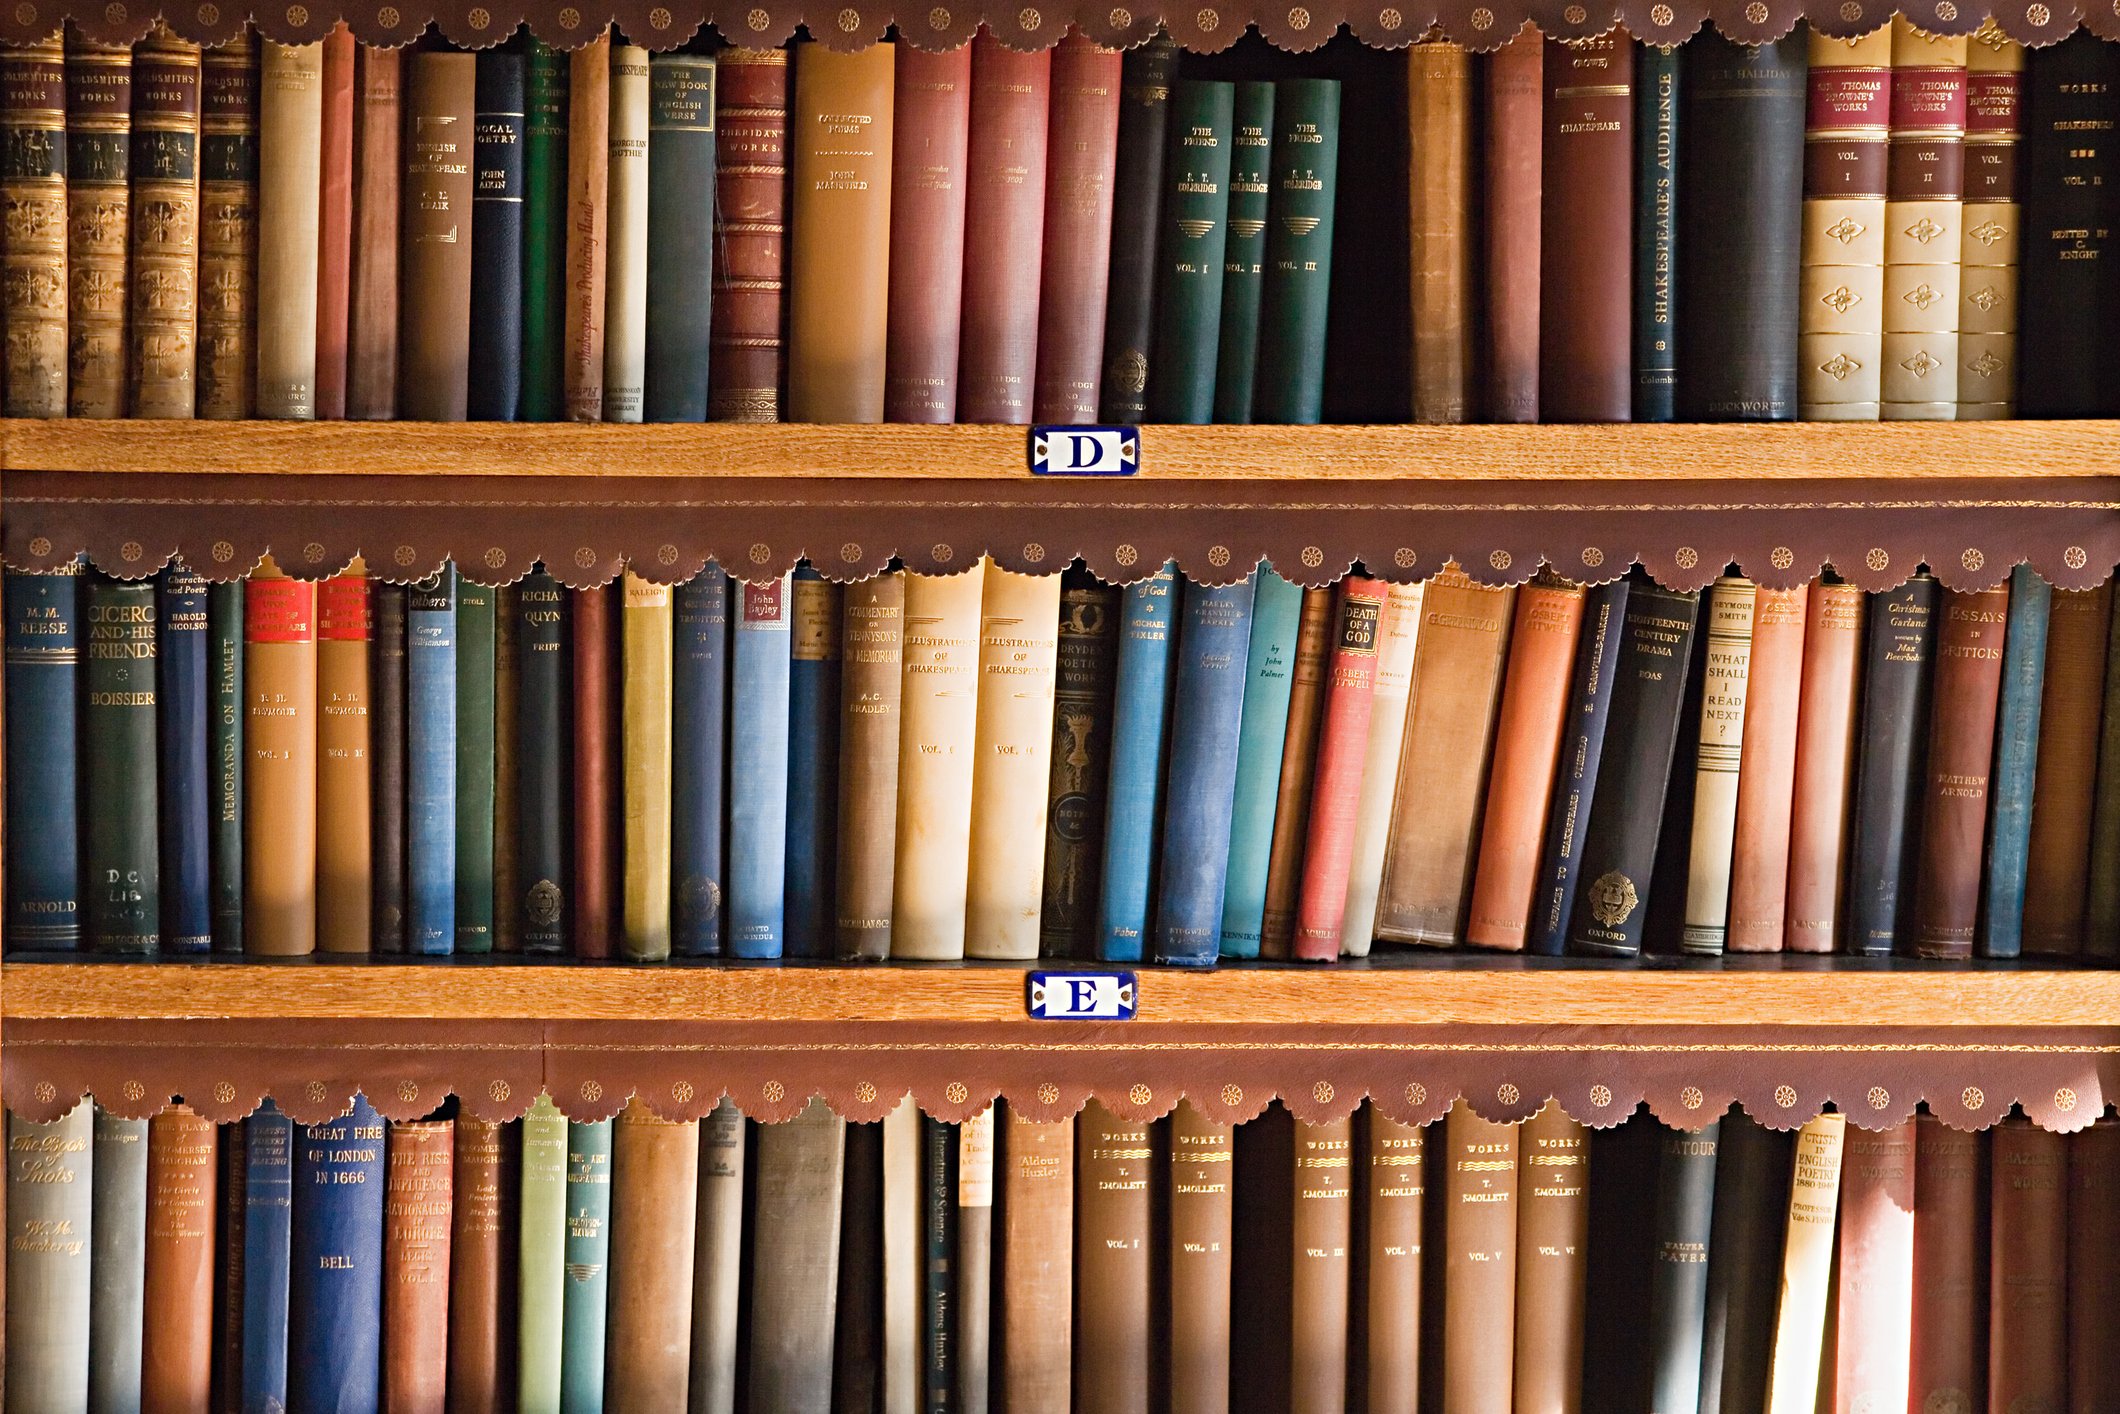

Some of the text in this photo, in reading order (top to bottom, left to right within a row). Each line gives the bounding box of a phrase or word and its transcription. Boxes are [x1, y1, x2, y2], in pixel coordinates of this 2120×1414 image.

[671, 71, 691, 80] THE
[679, 80, 708, 91] BOOK
[1842, 81, 1881, 91] THOMAS
[1920, 82, 1960, 91] THOMAS
[2059, 84, 2107, 93] WORKS
[674, 91, 688, 99] OF
[658, 101, 702, 110] ENGLISH
[1833, 103, 1867, 112] WORKS
[1912, 102, 1947, 112] WORKS
[664, 111, 696, 121] VERSE
[1977, 107, 2011, 116] WORKS
[1192, 127, 1212, 136] THE
[1242, 127, 1262, 136] THE
[1296, 124, 1316, 133] THE
[612, 149, 643, 158] DUTHIE
[1837, 152, 1858, 161] VOL.
[1918, 152, 1940, 161] VOL.
[480, 171, 505, 180] JOHN
[1986, 176, 1998, 185] IV
[1654, 72, 1672, 323] SHAKESPEARE'S AUDIENCE
[1067, 435, 1104, 468] D
[1138, 585, 1167, 598] of God
[411, 594, 447, 608] others
[463, 598, 485, 606] STOLL
[751, 594, 774, 604] John
[871, 594, 878, 603] A
[1906, 593, 1914, 602] A
[1714, 601, 1753, 611] SEYMOUR
[26, 608, 60, 618] M. M.
[172, 613, 207, 621] HAROLD
[848, 607, 899, 618] COMMENTARY
[1345, 607, 1377, 620] DEATH
[1718, 612, 1747, 621] SMITH
[1951, 606, 2005, 623] ESSAYS
[20, 622, 68, 634] REESE
[1350, 620, 1370, 631] OF A
[1890, 617, 1928, 628] Garland
[849, 630, 898, 642] TENNYSON'S
[1346, 631, 1371, 643] GOD
[1634, 628, 1681, 644] CENTURY
[1970, 630, 1981, 639] IN
[89, 643, 158, 660] FRIENDS
[533, 642, 561, 651] FRIPP
[1270, 644, 1280, 654] by
[1636, 643, 1673, 657] DRAMA
[1896, 643, 1916, 652] Max
[856, 650, 899, 663] MEMORIAM
[934, 651, 948, 661] OF
[1013, 653, 1027, 662] OF
[1264, 657, 1282, 666] John
[1710, 653, 1748, 665] WHAT
[1260, 669, 1285, 679] Palmer
[1639, 669, 1662, 681] BOAS
[1708, 667, 1746, 679] SHALL
[1723, 682, 1729, 692] I
[91, 692, 156, 706] BOISSIER
[1708, 695, 1742, 707] READ
[850, 704, 891, 714] BRADLEY
[1706, 709, 1740, 721] NEXT
[222, 638, 235, 821] MEMORANDA ON HAMLET
[1719, 724, 1726, 736] ?
[921, 744, 941, 754] VOL.
[997, 745, 1018, 755] VOL.
[1938, 774, 1986, 786] MATTHEW
[1940, 787, 1983, 798] ARNOLD
[1558, 866, 1567, 880] TO
[20, 901, 76, 913] ARNOLD
[1114, 926, 1138, 938] Faber
[1587, 928, 1626, 942] OXFORD
[1066, 980, 1098, 1014] E
[179, 1123, 211, 1132] PLAYS
[307, 1126, 383, 1141] GREAT FIRE
[1101, 1132, 1147, 1142] WORKS
[1804, 1132, 1838, 1145] CRISIS
[39, 1134, 88, 1153] Book
[1180, 1135, 1225, 1145] WORKS
[1307, 1141, 1348, 1150] WORKS
[1382, 1139, 1424, 1148] WORKS
[1538, 1139, 1581, 1148] WORKS
[1467, 1144, 1510, 1154] WORKS
[1815, 1146, 1825, 1154] IN
[45, 1151, 63, 1168] of
[309, 1149, 376, 1163] OF LONDON
[392, 1152, 449, 1165] THE RISE
[591, 1153, 606, 1164] ART
[929, 1129, 948, 1186] Literature
[1021, 1156, 1060, 1167] Aldous
[1798, 1153, 1838, 1168] ENGLISH
[16, 1160, 75, 1185] Snobs
[413, 1168, 431, 1176] AND
[1021, 1167, 1060, 1179] Huxley
[1798, 1167, 1835, 1180] POETRY
[316, 1171, 365, 1185] IN 1666
[388, 1178, 450, 1192] INFLUENCE
[413, 1193, 427, 1201] OF
[394, 1226, 444, 1241] EUROPE
[1664, 1241, 1704, 1251] WALTER
[320, 1256, 354, 1270] BELL
[1660, 1252, 1707, 1263] PATER
[931, 1291, 948, 1373] Aldous Huxley
